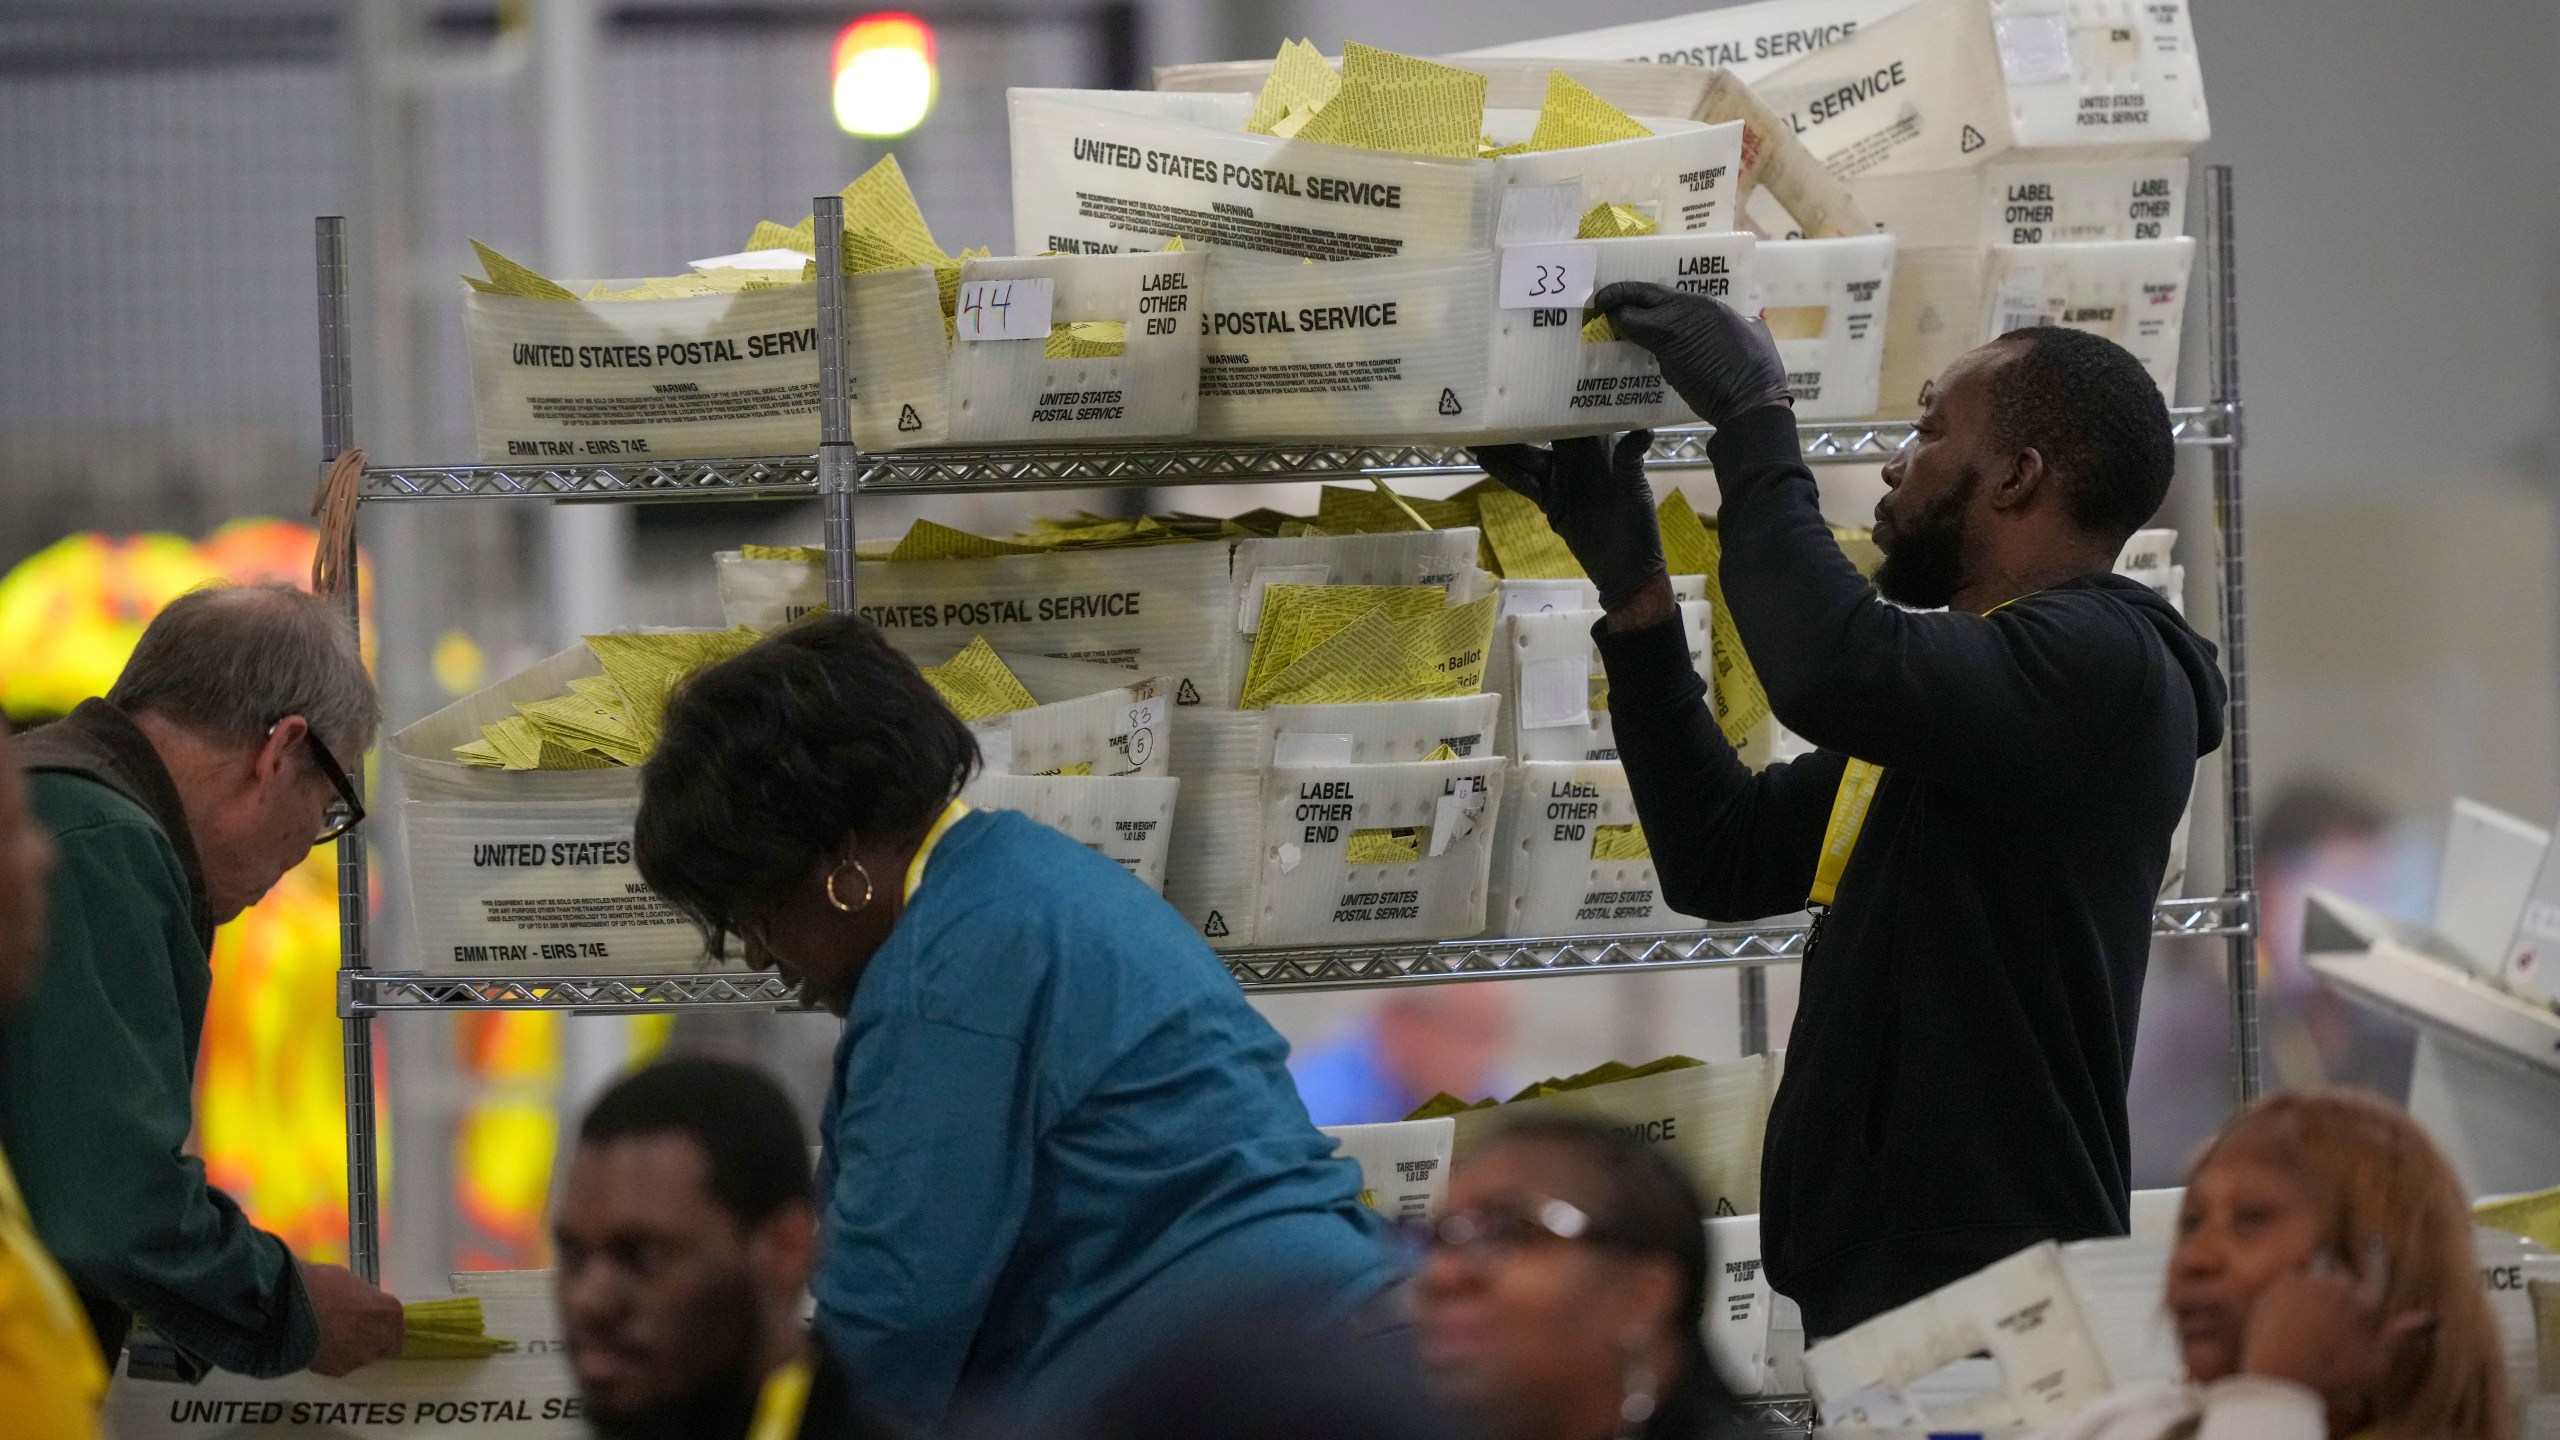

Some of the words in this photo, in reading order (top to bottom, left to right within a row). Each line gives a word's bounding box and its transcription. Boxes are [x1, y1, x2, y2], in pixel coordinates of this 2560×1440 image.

[1754, 22, 1857, 58] SERVICE
[1810, 60, 1906, 126] SERVICE
[1074, 137, 1141, 170] UNITED
[1146, 150, 1217, 183] STATES
[1223, 163, 1301, 197] POSTAL
[1306, 176, 1401, 208] SERVICE
[1679, 174, 1699, 186] TARE
[1699, 166, 1727, 182] WEIGHT
[1689, 182, 1701, 192] 1.0
[1702, 178, 1715, 190] LBS
[2008, 184, 2054, 201] LABEL
[2132, 179, 2170, 198] LABEL
[1212, 202, 1254, 218] WARNING
[2006, 206, 2054, 223] OTHER
[2130, 202, 2170, 219] OTHER
[2013, 228, 2042, 244] END
[2136, 223, 2160, 239] END
[1678, 256, 1730, 276] LABEL
[1142, 273, 1188, 291] LABEL
[1529, 265, 1566, 296] 33
[1676, 278, 1729, 296] OTHER
[964, 285, 1011, 333] 44
[1139, 295, 1187, 313] OTHER
[1214, 310, 1295, 335] POSTAL
[1300, 302, 1397, 332] SERVICE
[1533, 308, 1568, 327] END
[1147, 318, 1176, 335] END
[513, 343, 574, 368] UNITED
[579, 346, 651, 368] STATES
[656, 339, 743, 366] POSTAL
[747, 328, 819, 358] SERVI
[1207, 354, 1249, 364] WARNING
[653, 382, 698, 394] WARNING
[1577, 377, 1618, 392] UNITED
[1619, 375, 1662, 390] STATES
[1040, 393, 1078, 405] UNITED
[1080, 391, 1122, 404] STATES
[1570, 394, 1613, 409] POSTAL
[1614, 390, 1664, 406] SERVICE
[1032, 408, 1074, 422] POSTAL
[1076, 407, 1124, 420] SERVICE
[507, 440, 539, 456] EMM
[539, 441, 574, 456] TRAY
[586, 439, 619, 454] EIRS
[621, 439, 650, 453] 74E
[860, 604, 938, 628] STATES
[945, 600, 1032, 626] POSTAL
[1038, 592, 1140, 622] SERVICE
[1448, 649, 1481, 671] Ballot
[1129, 707, 1152, 728] 83
[1108, 734, 1128, 748] TARE
[1137, 738, 1144, 753] 5
[1457, 734, 1481, 746] WEIGHT
[1586, 749, 1619, 760] UNITED
[1300, 782, 1354, 800] LABEL
[1444, 775, 1488, 795] LEL
[1551, 782, 1600, 798] LABEL
[1296, 804, 1352, 821] OTHER
[1547, 803, 1598, 820] OTHER
[1115, 822, 1132, 830] TARE
[1132, 821, 1156, 830] WEIGHT
[1304, 826, 1339, 842] END
[1554, 824, 1585, 841] END
[1124, 832, 1132, 840] 1.0
[1133, 832, 1146, 840] LBS
[473, 844, 546, 867] UNITED
[551, 841, 630, 866] STATES
[1340, 893, 1378, 906] UNITED
[1379, 890, 1418, 905] STATES
[1584, 893, 1618, 904] UNITED
[1620, 890, 1653, 902] STATES
[1332, 908, 1372, 922] POSTAL
[1374, 906, 1419, 920] SERVICE
[1576, 908, 1611, 920] POSTAL
[1614, 906, 1653, 919] SERVICE
[454, 947, 488, 962] EMM
[489, 946, 528, 960] TRAY
[541, 944, 577, 960] EIRS
[580, 943, 608, 957] 74E
[1396, 1162, 1414, 1172] TARE
[1414, 1160, 1439, 1170] WEIGHT
[1406, 1172, 1414, 1182] 1.0
[1416, 1170, 1428, 1181] LBS
[1726, 1262, 1741, 1273] TARE
[170, 1400, 283, 1424] UNITED
[290, 1402, 405, 1425] STATES
[414, 1400, 532, 1424] POSTAL
